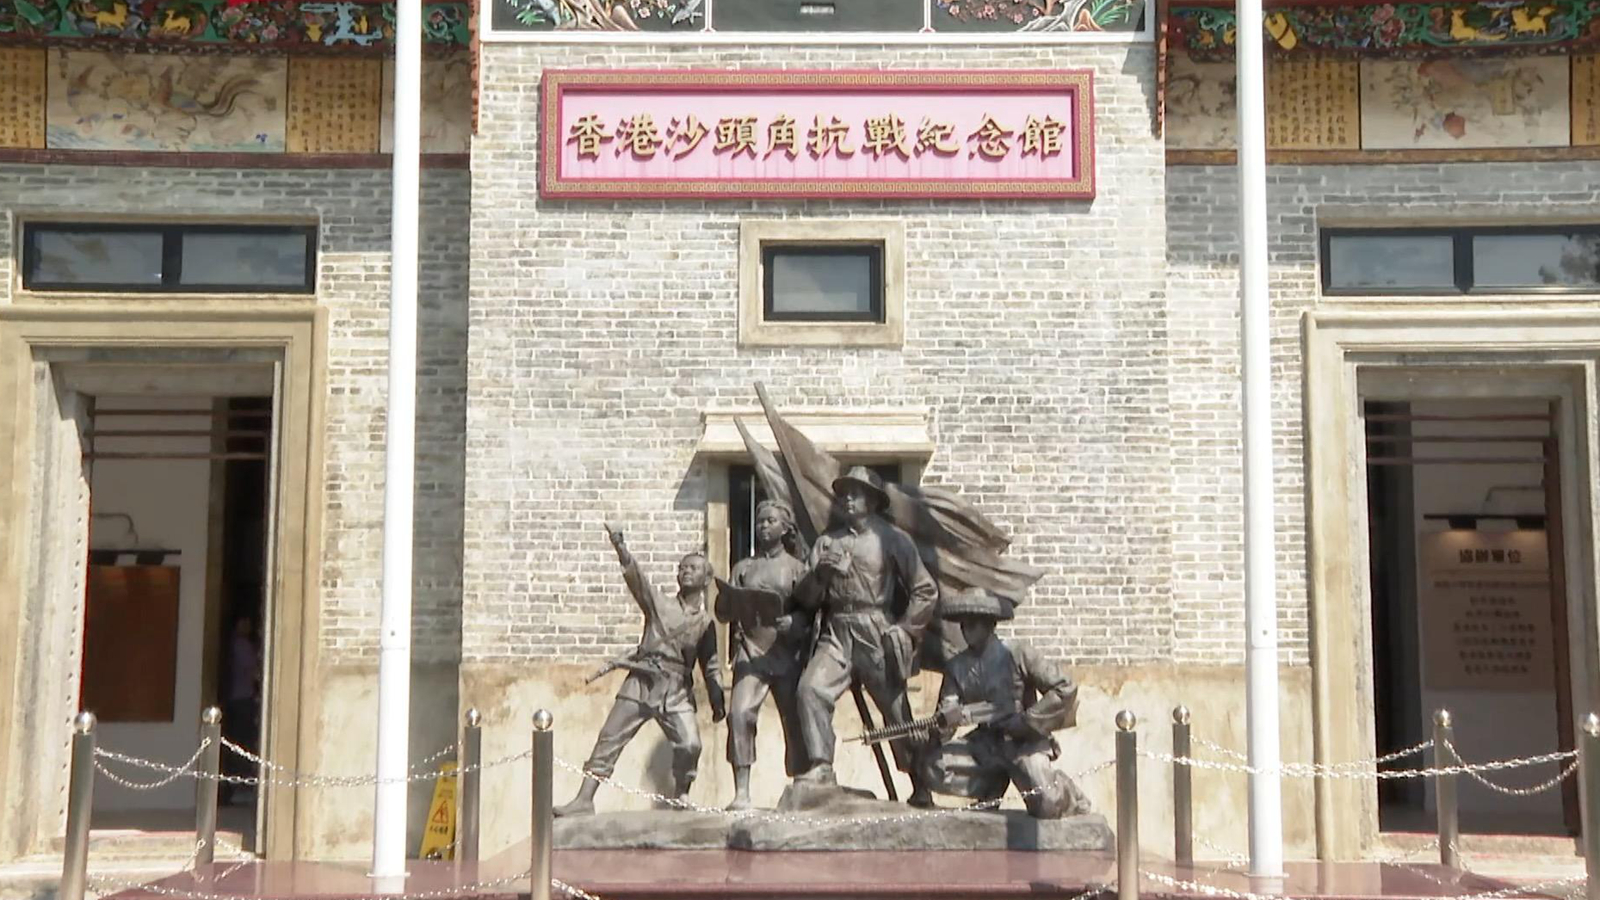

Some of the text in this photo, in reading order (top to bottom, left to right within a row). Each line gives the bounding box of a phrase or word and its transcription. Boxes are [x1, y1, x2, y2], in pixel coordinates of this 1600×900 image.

[567, 113, 1066, 161] 香港沙頭角抗戰紀念館
